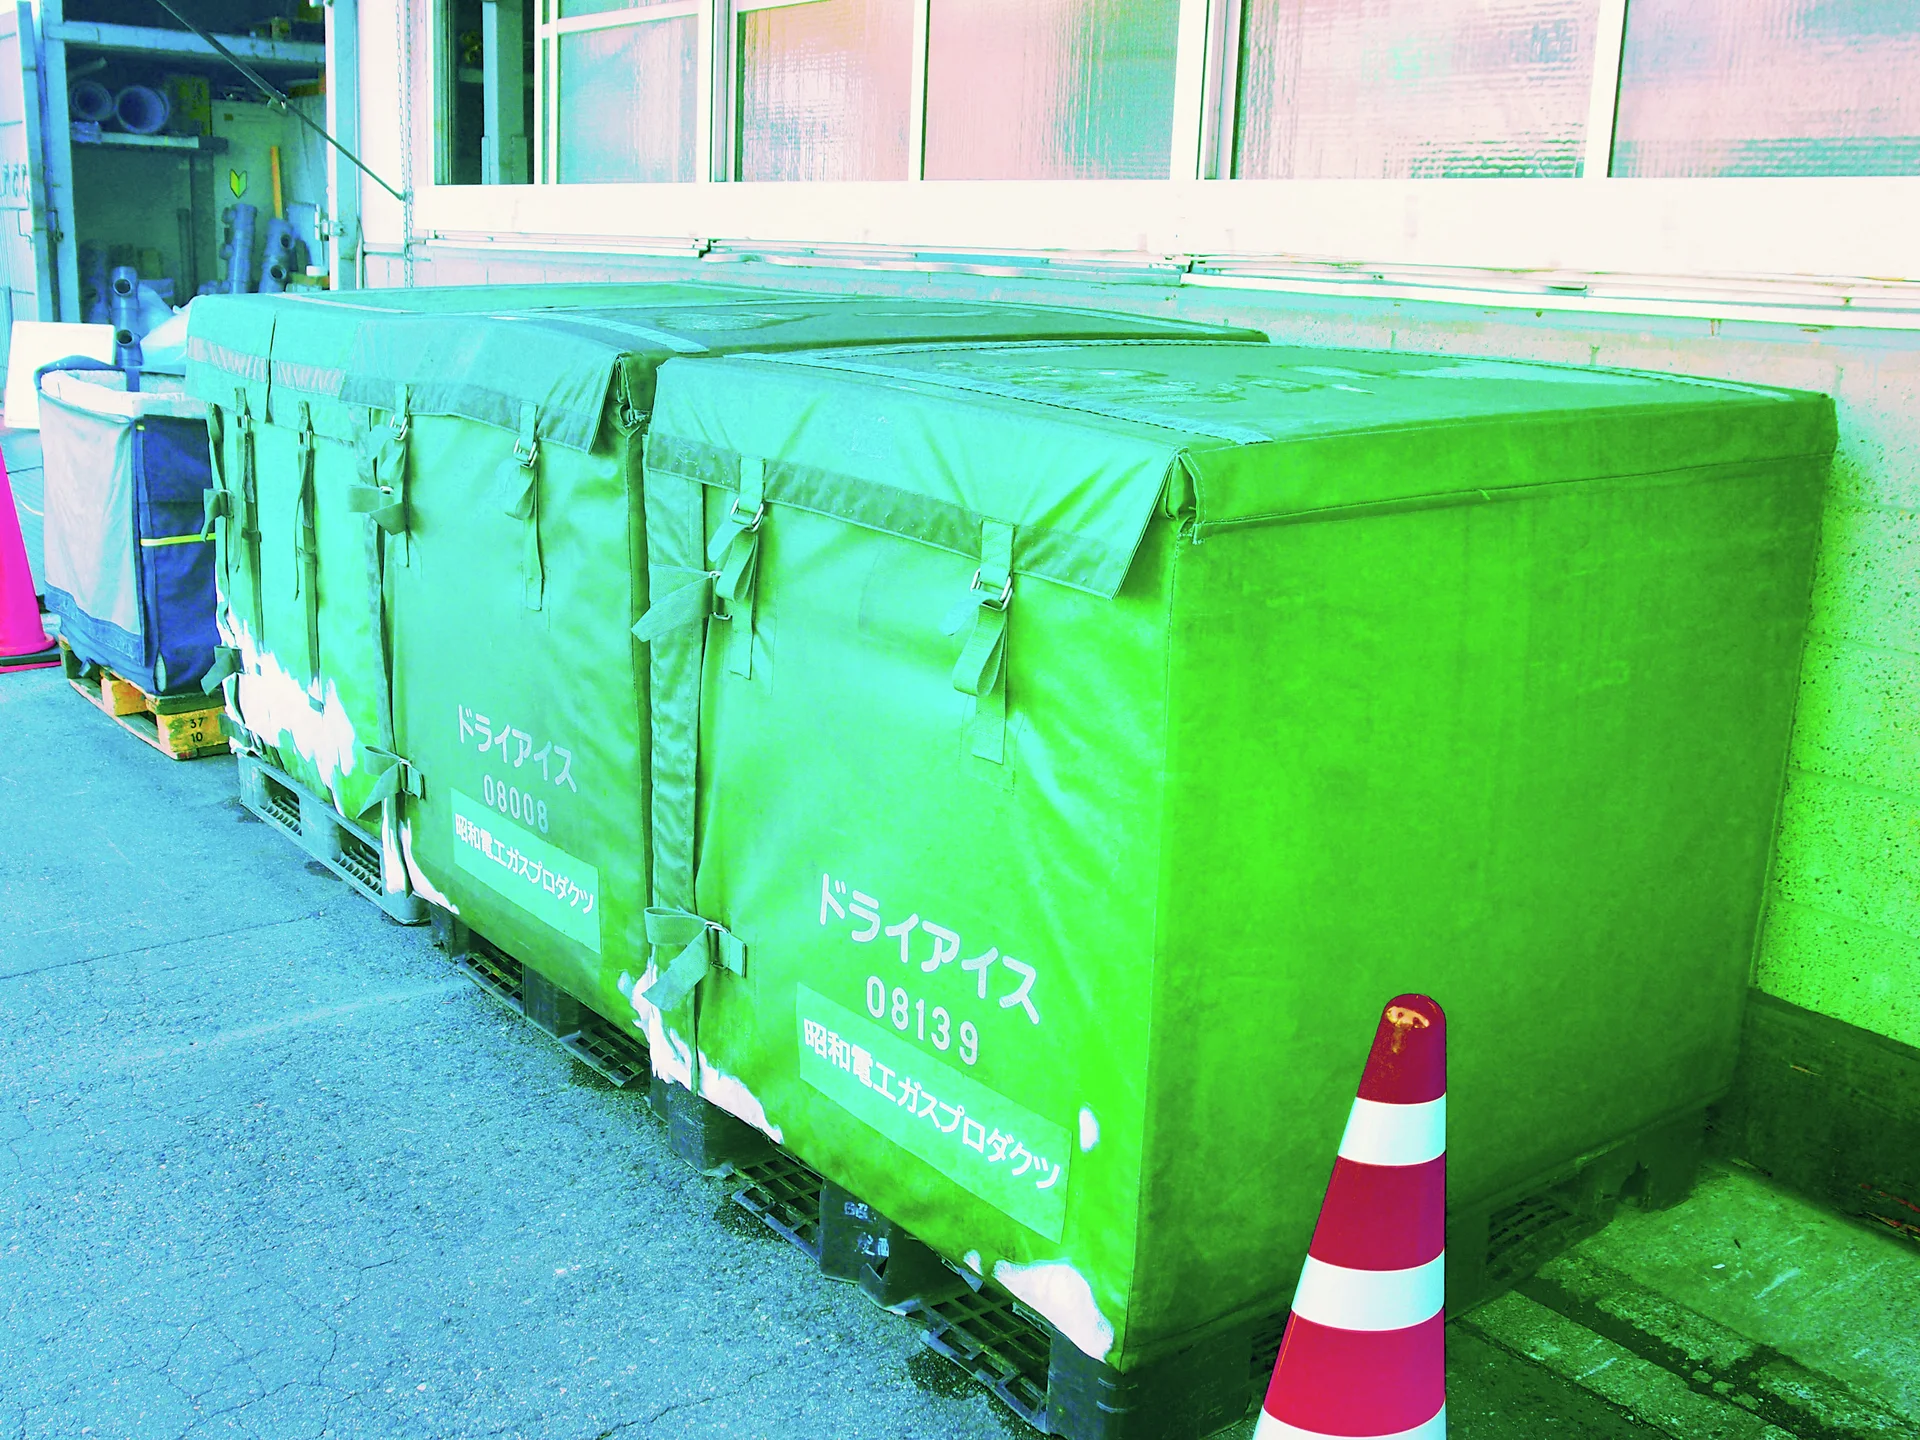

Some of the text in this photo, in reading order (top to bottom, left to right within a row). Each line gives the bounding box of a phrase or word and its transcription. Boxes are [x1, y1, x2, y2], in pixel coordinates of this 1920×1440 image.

[190, 717, 206, 728] 37
[191, 731, 203, 743] 10
[458, 704, 577, 793] ドライアイス
[483, 775, 549, 834] 08008
[454, 813, 595, 914] 昭和電工ガスプロダクツ
[819, 873, 1040, 1026] ドライアイス
[866, 976, 979, 1066] 08139
[803, 1018, 1060, 1189] 昭和電工ガスプロダクツ
